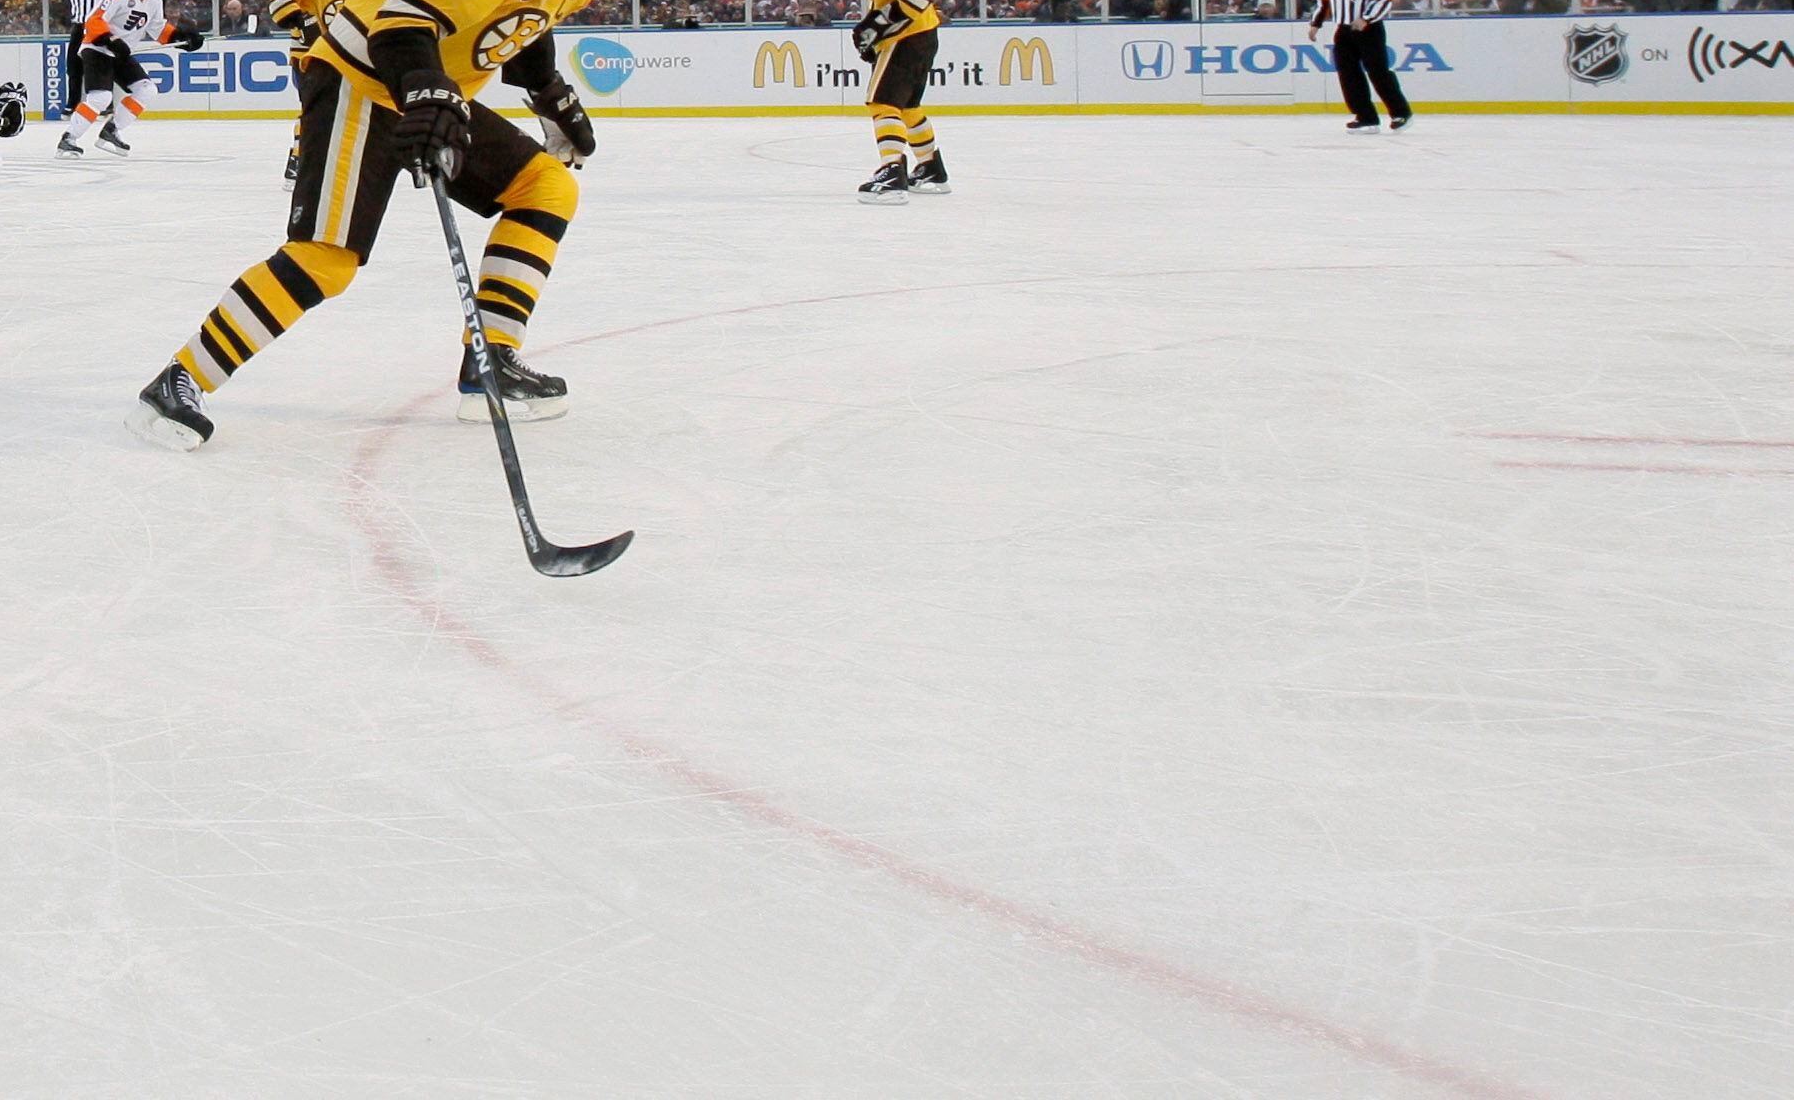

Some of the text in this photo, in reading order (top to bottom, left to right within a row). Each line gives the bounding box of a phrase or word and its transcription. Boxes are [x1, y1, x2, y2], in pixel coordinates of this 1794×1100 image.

[132, 50, 299, 93] GEIC
[580, 50, 692, 74] Compuware
[1184, 43, 1454, 74] HONA
[1577, 39, 1617, 72] NHL
[1641, 48, 1668, 62] ON
[46, 44, 62, 110] Reebok
[816, 63, 860, 87] i'm
[963, 61, 983, 86] it
[454, 261, 491, 375] EASTON
